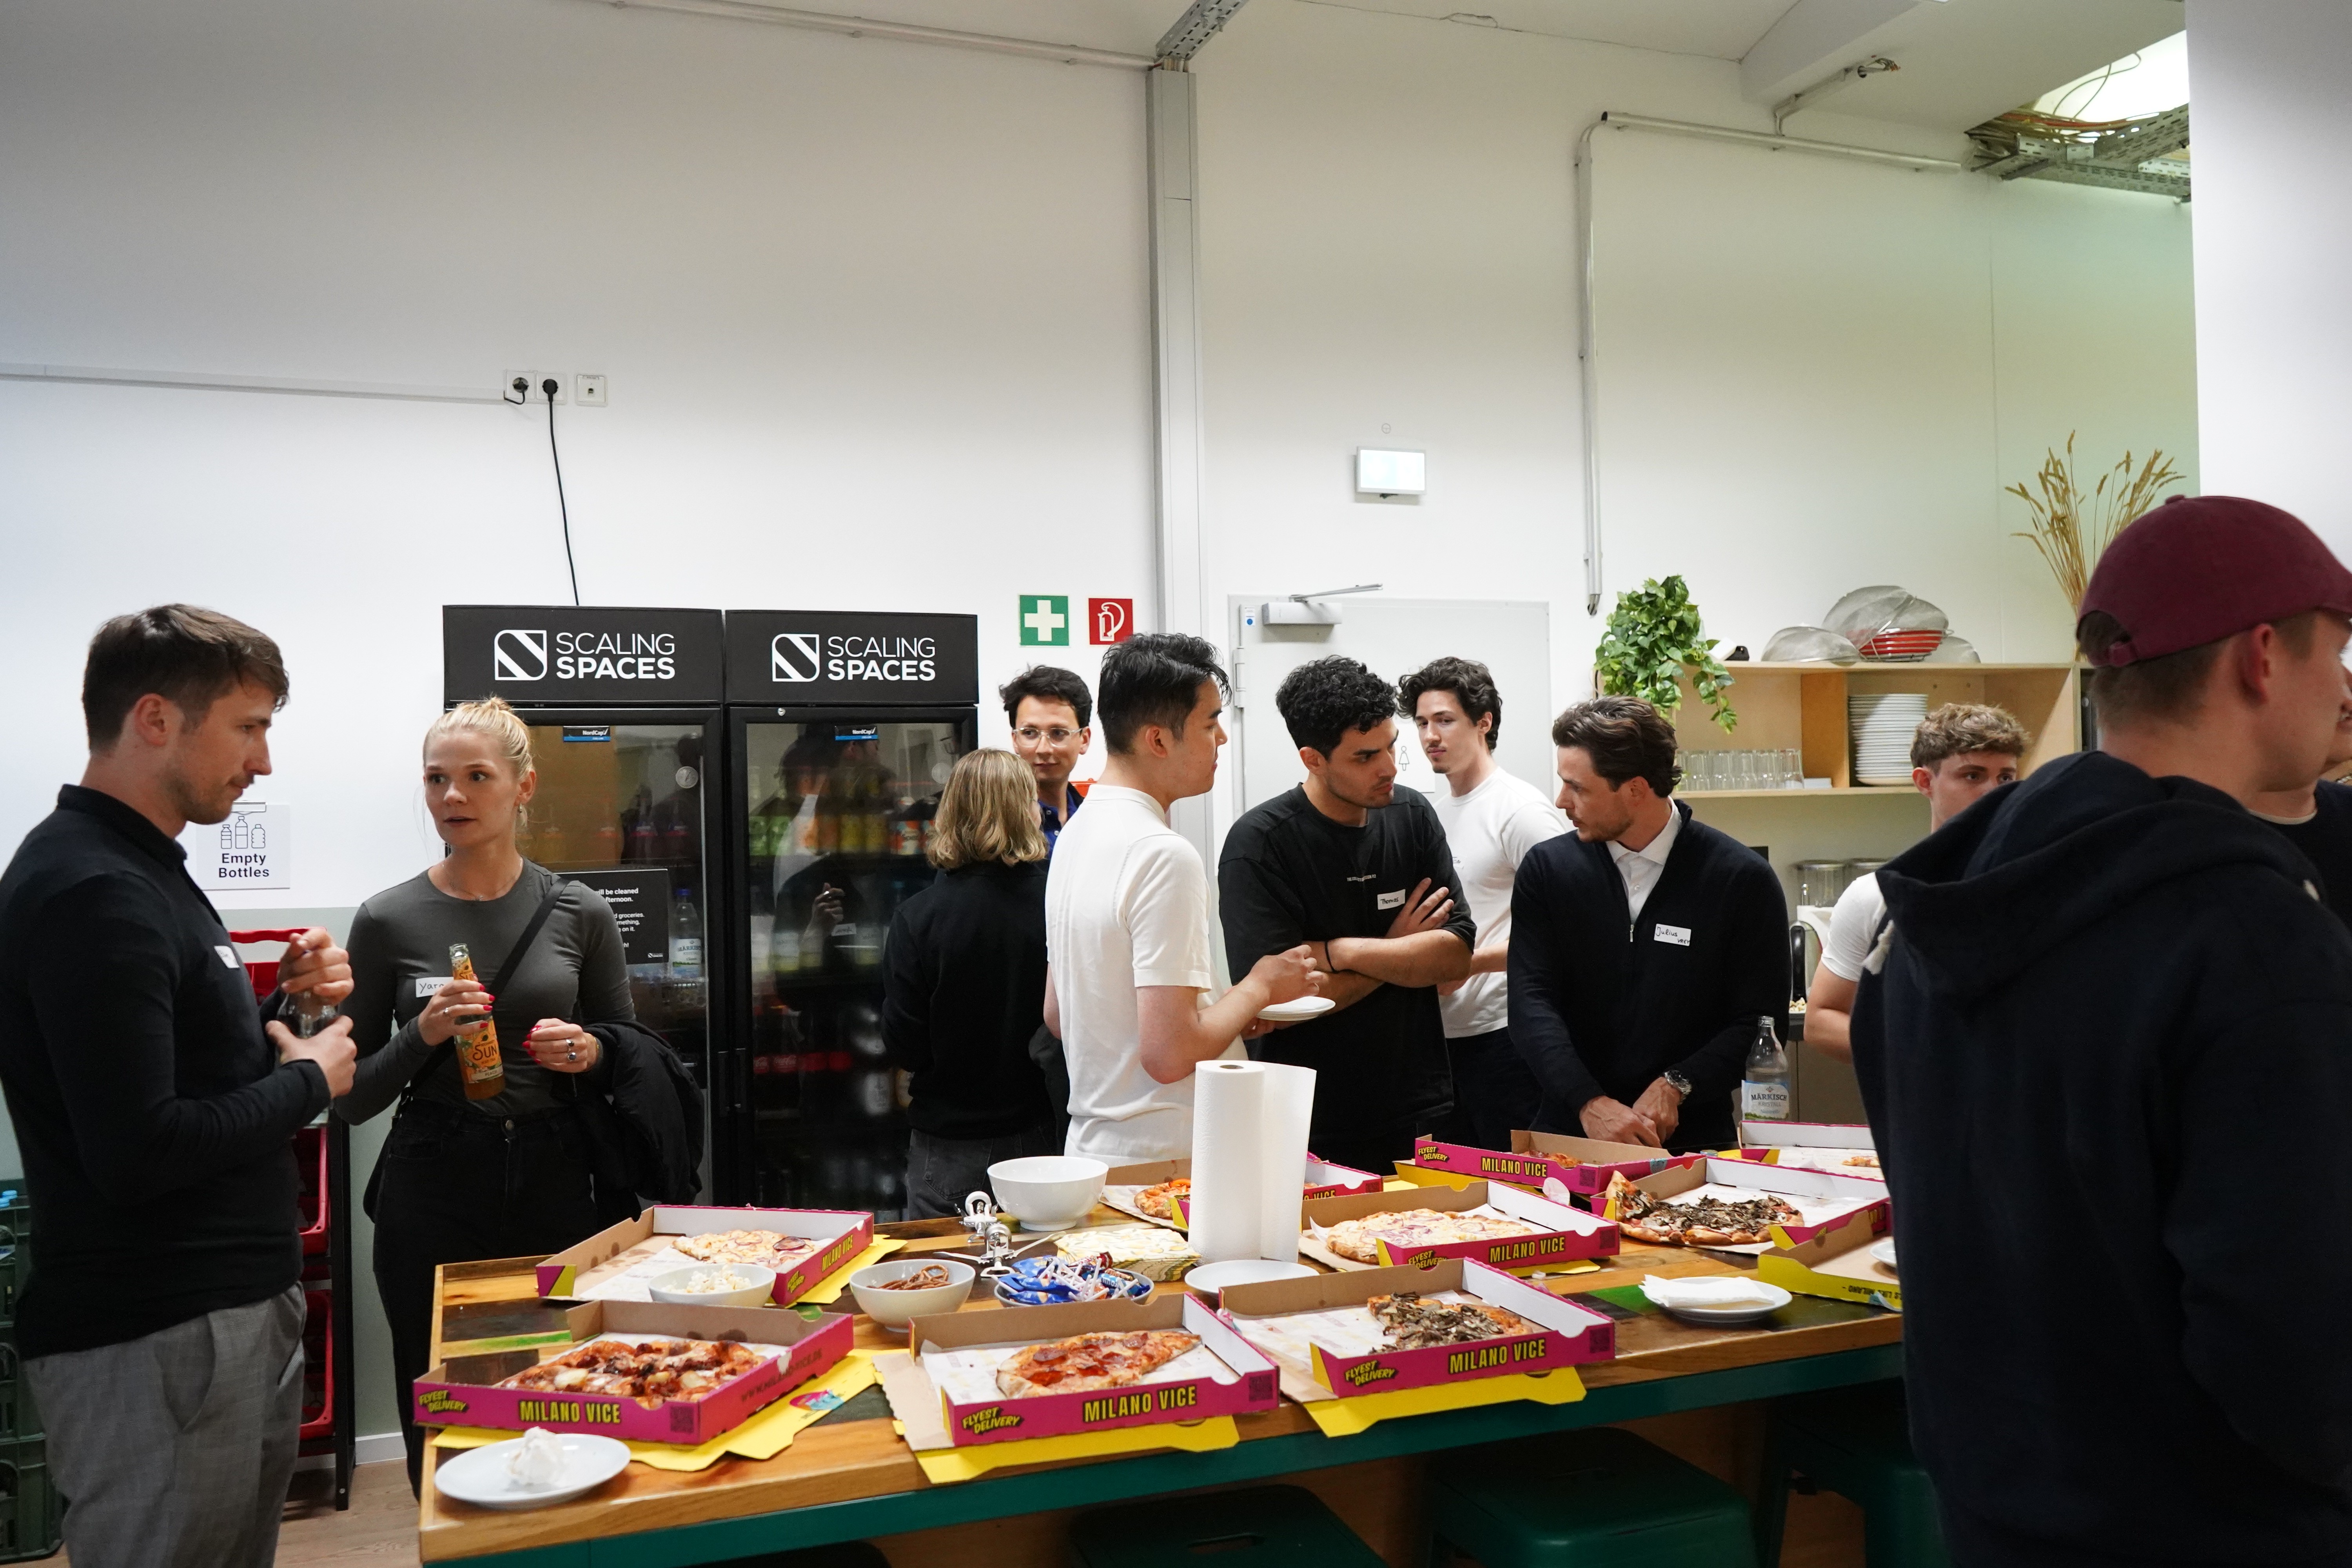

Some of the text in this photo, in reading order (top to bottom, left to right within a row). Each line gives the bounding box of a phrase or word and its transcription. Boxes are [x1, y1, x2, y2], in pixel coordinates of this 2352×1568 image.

[556, 632, 675, 655] SCALING
[828, 636, 935, 658] SCALING
[556, 657, 675, 679] SPACES
[828, 659, 936, 681] SPACES
[221, 853, 266, 866] Empty
[219, 867, 269, 878] Bottles
[1655, 926, 1678, 936] Julius
[1751, 1093, 1787, 1101] MÄRKISCH
[1418, 1146, 1437, 1155] FLYEST
[1423, 1153, 1448, 1161] DELIVERY
[1482, 1157, 1547, 1177] MILANO VICE
[822, 1234, 853, 1272] MILANO VICE
[1408, 1250, 1434, 1264] FLYEST
[1490, 1236, 1565, 1263] MILANO VICE
[1450, 1339, 1545, 1374] MILANO VICE
[1345, 1360, 1377, 1381] FLYEST
[1355, 1368, 1396, 1386] DELIVERY
[419, 1390, 449, 1405] FLYEST
[428, 1400, 466, 1412] DELIVERY
[1084, 1386, 1196, 1422] MILANO VICE
[519, 1401, 621, 1424] MILANO VICE
[962, 1406, 1000, 1429] FLYEST
[974, 1415, 1020, 1434] DELIVERY
